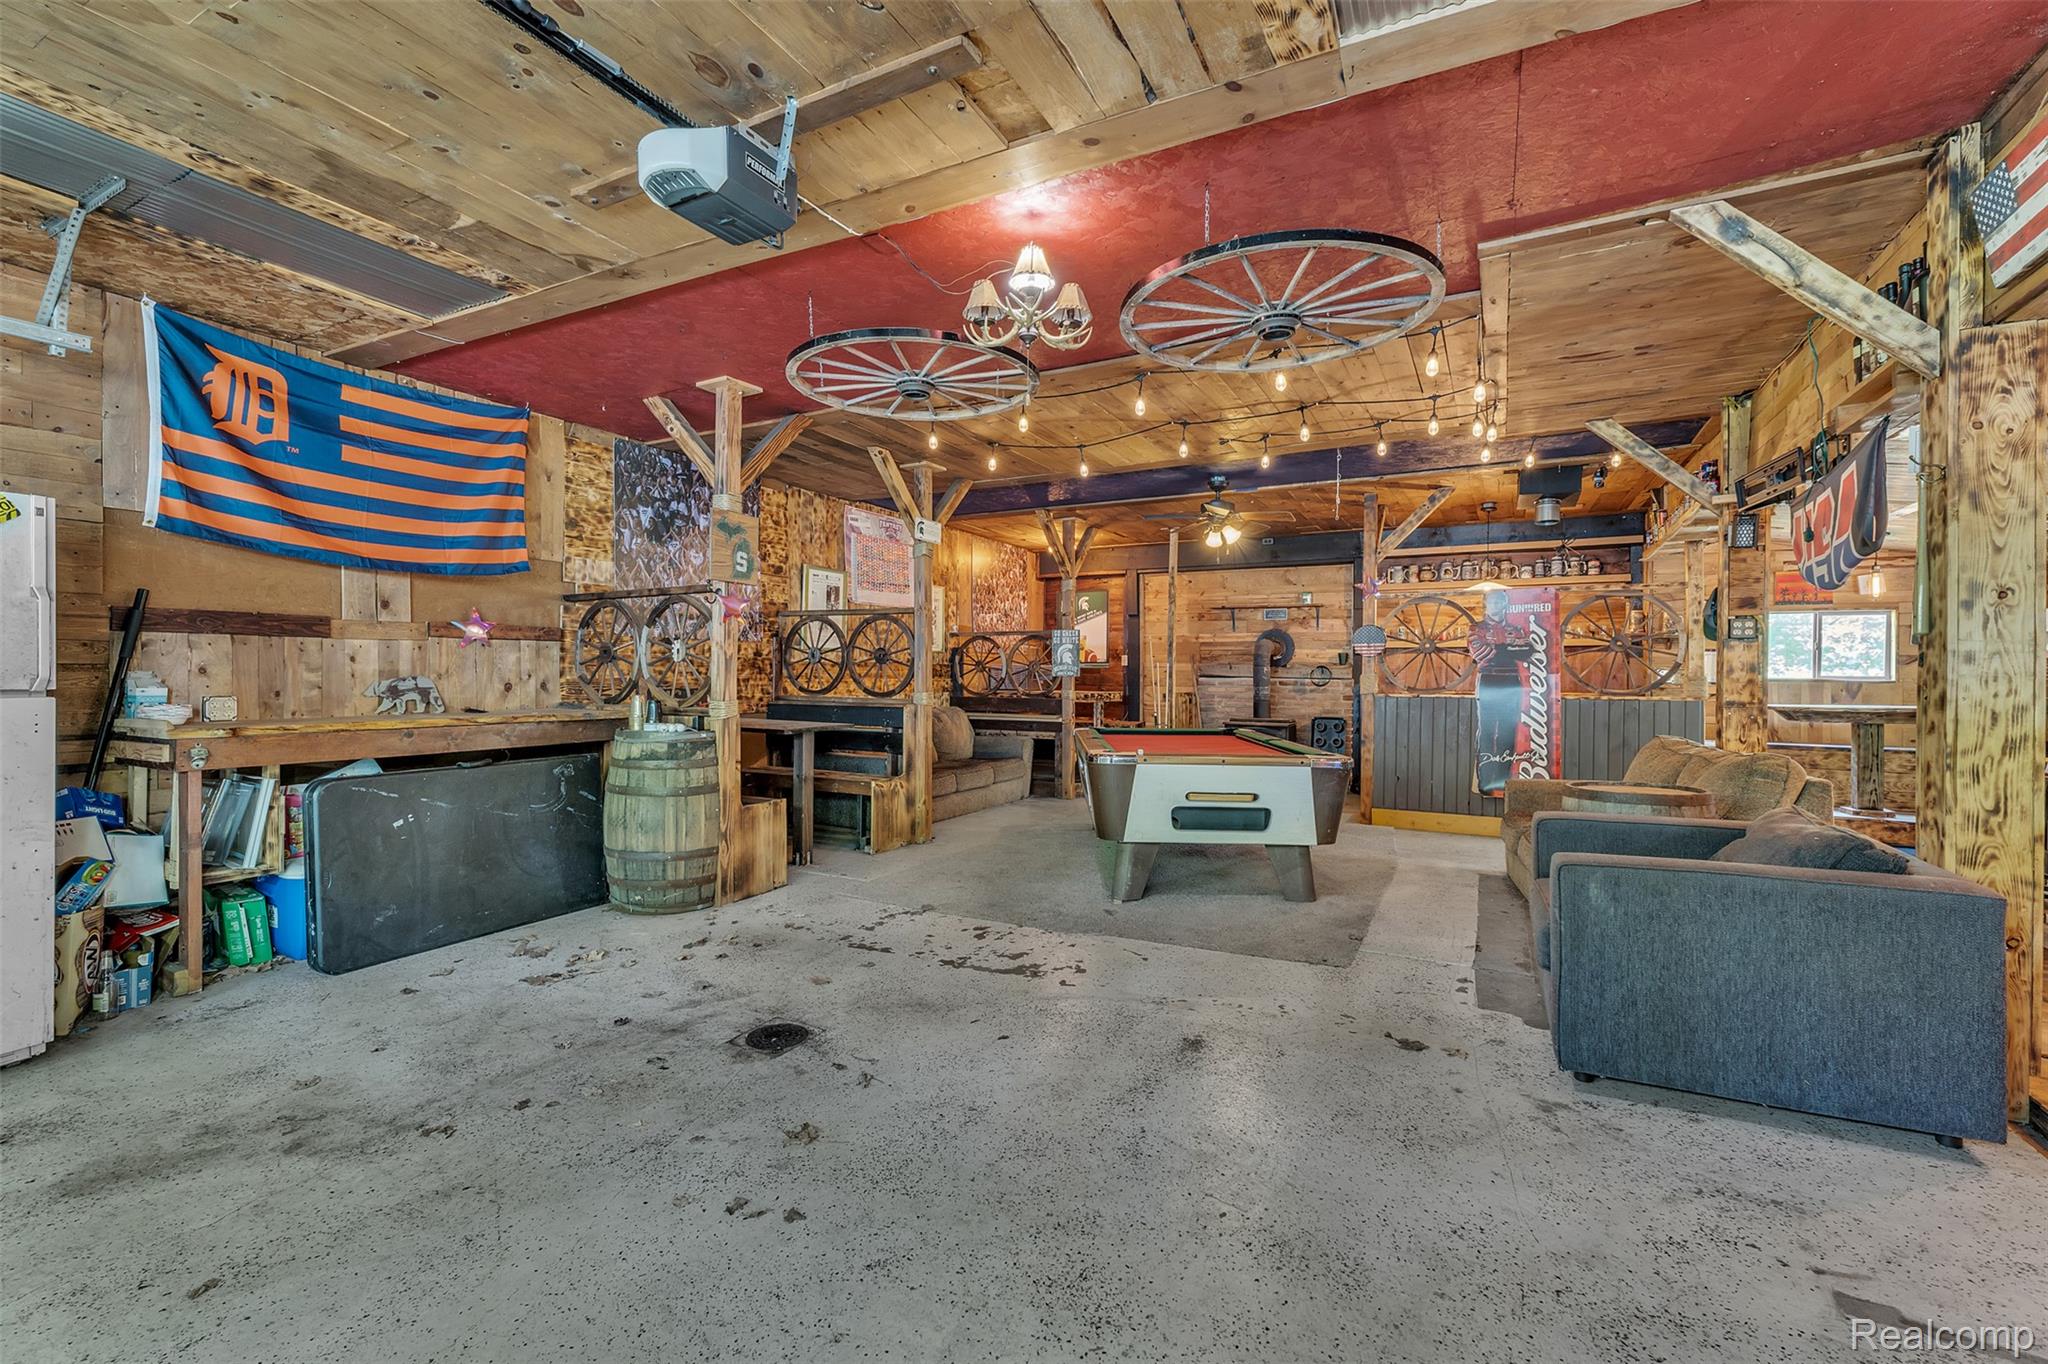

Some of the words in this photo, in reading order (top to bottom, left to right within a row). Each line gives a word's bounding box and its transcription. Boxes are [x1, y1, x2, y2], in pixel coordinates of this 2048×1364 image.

[747, 155, 783, 188] PERFORM
[286, 445, 299, 455] TM
[736, 551, 748, 573] S
[1534, 602, 1552, 612] RED
[1518, 614, 1549, 780] Budweiser
